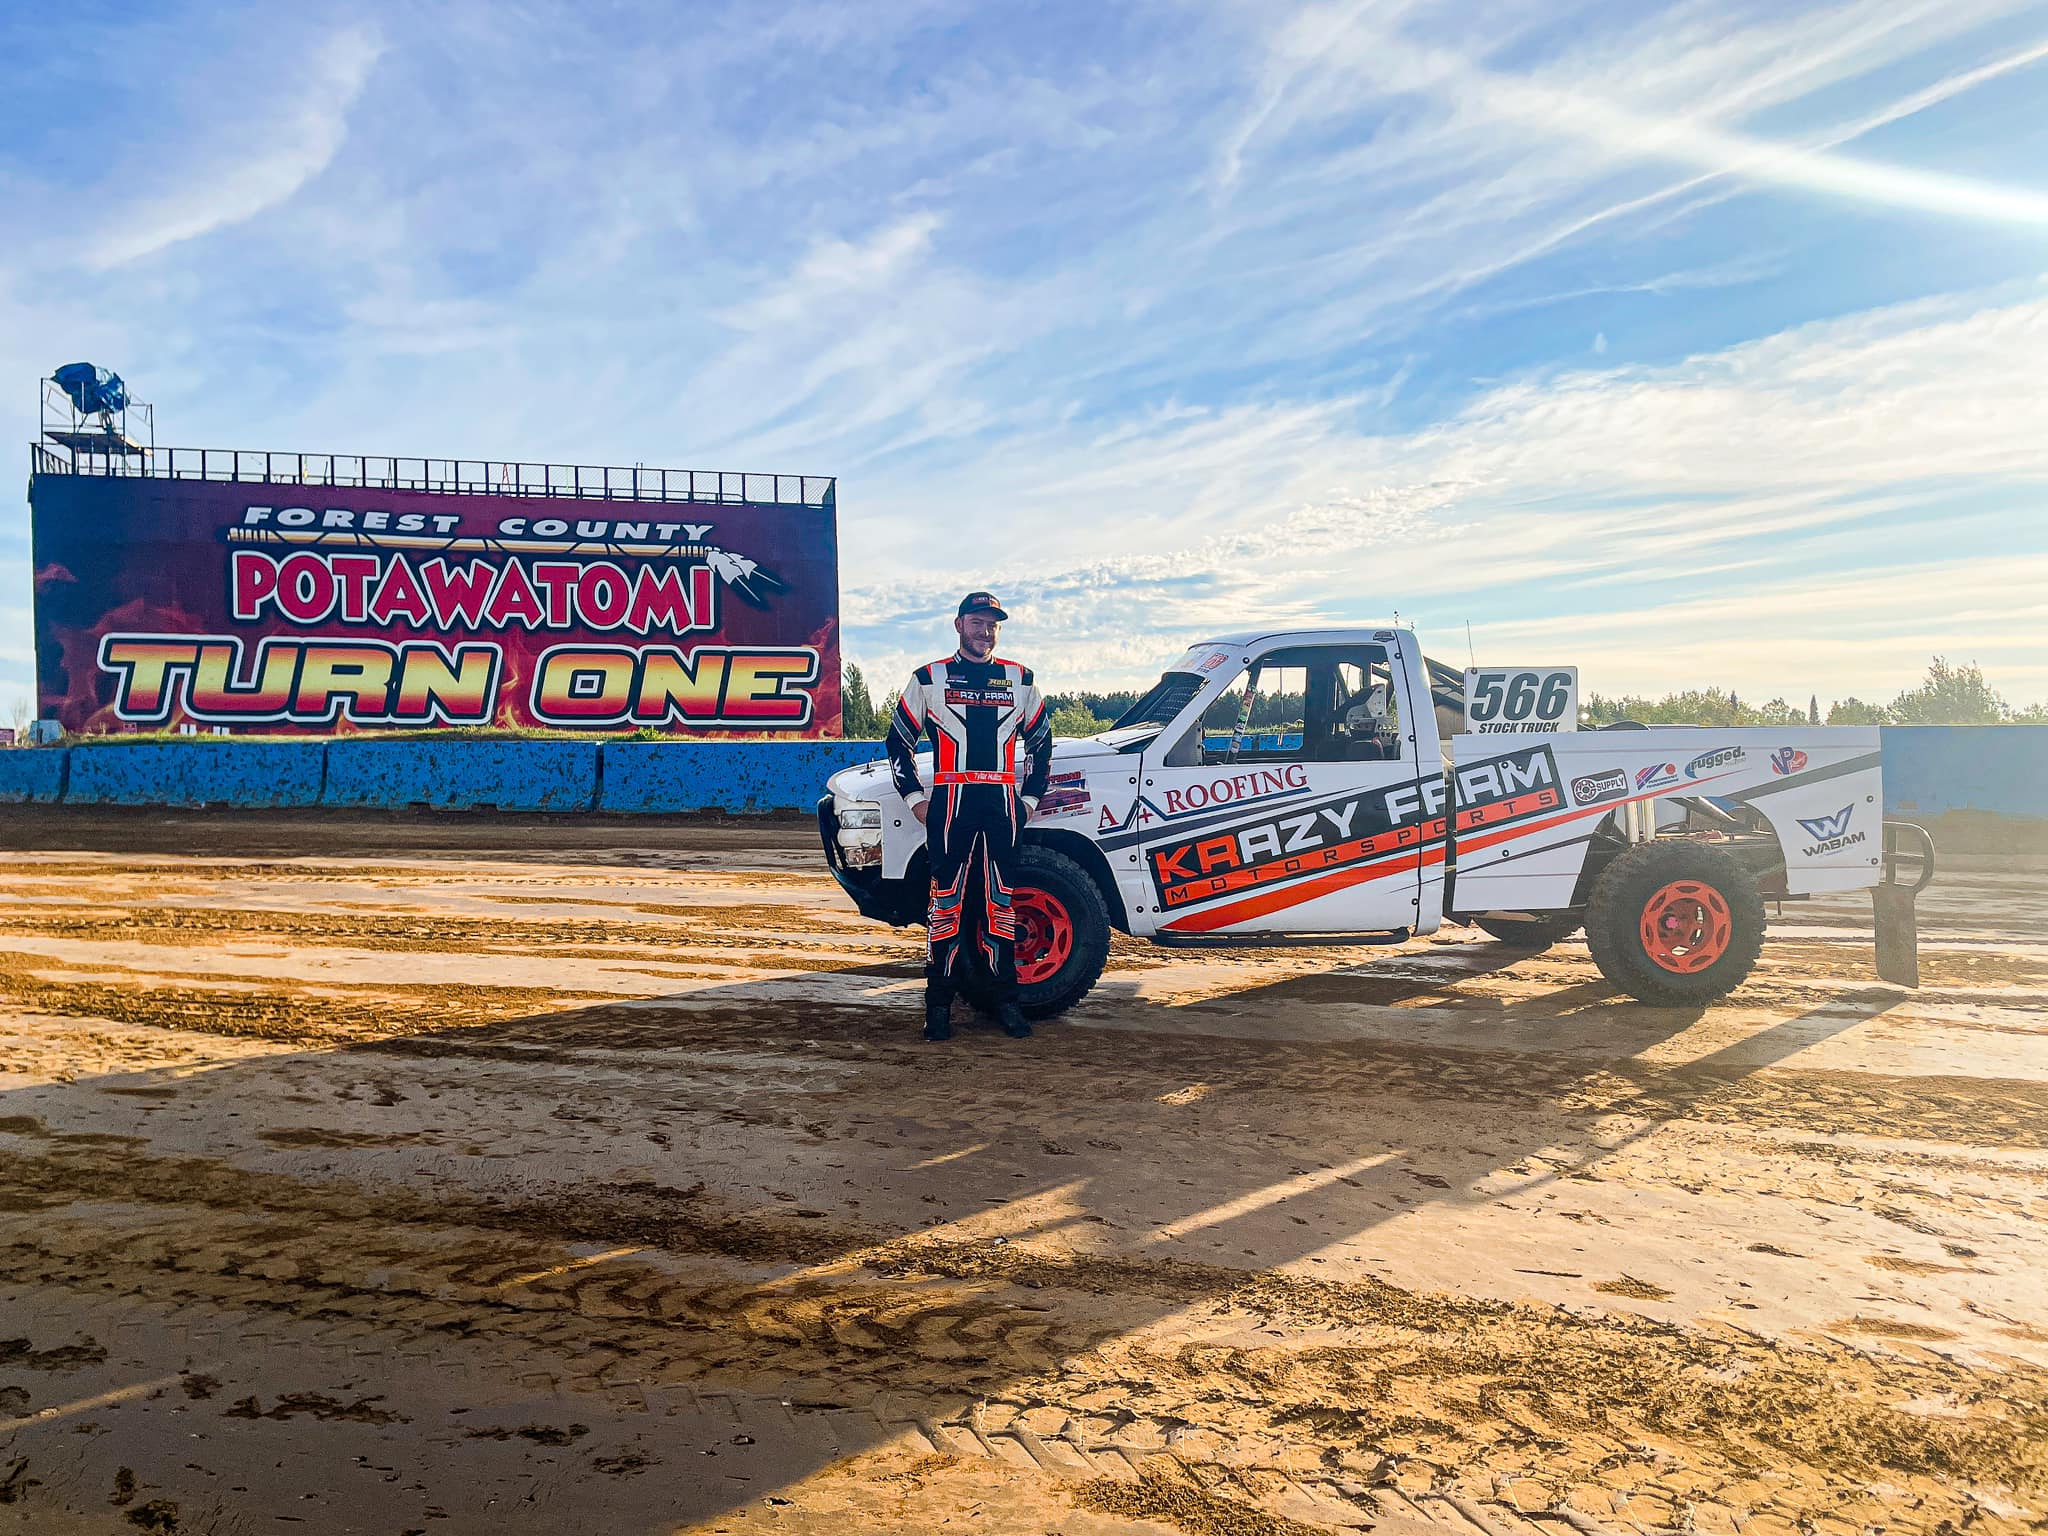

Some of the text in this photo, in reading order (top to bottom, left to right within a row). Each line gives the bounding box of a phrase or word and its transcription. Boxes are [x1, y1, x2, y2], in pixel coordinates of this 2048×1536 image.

[244, 507, 714, 541] FOREST COUNTY
[232, 550, 715, 636] POTAWATOMI
[97, 633, 820, 726] TURN ONE
[1470, 672, 1572, 721] 566
[1479, 721, 1560, 734] STOCK TRUCK
[1163, 764, 1308, 814] ROOFING
[1596, 776, 1625, 792] SUPPLY
[1154, 751, 1553, 885] KRAZY FARM
[1170, 791, 1554, 901] MOTORSPORTS
[1802, 831, 1866, 857] WABAM
